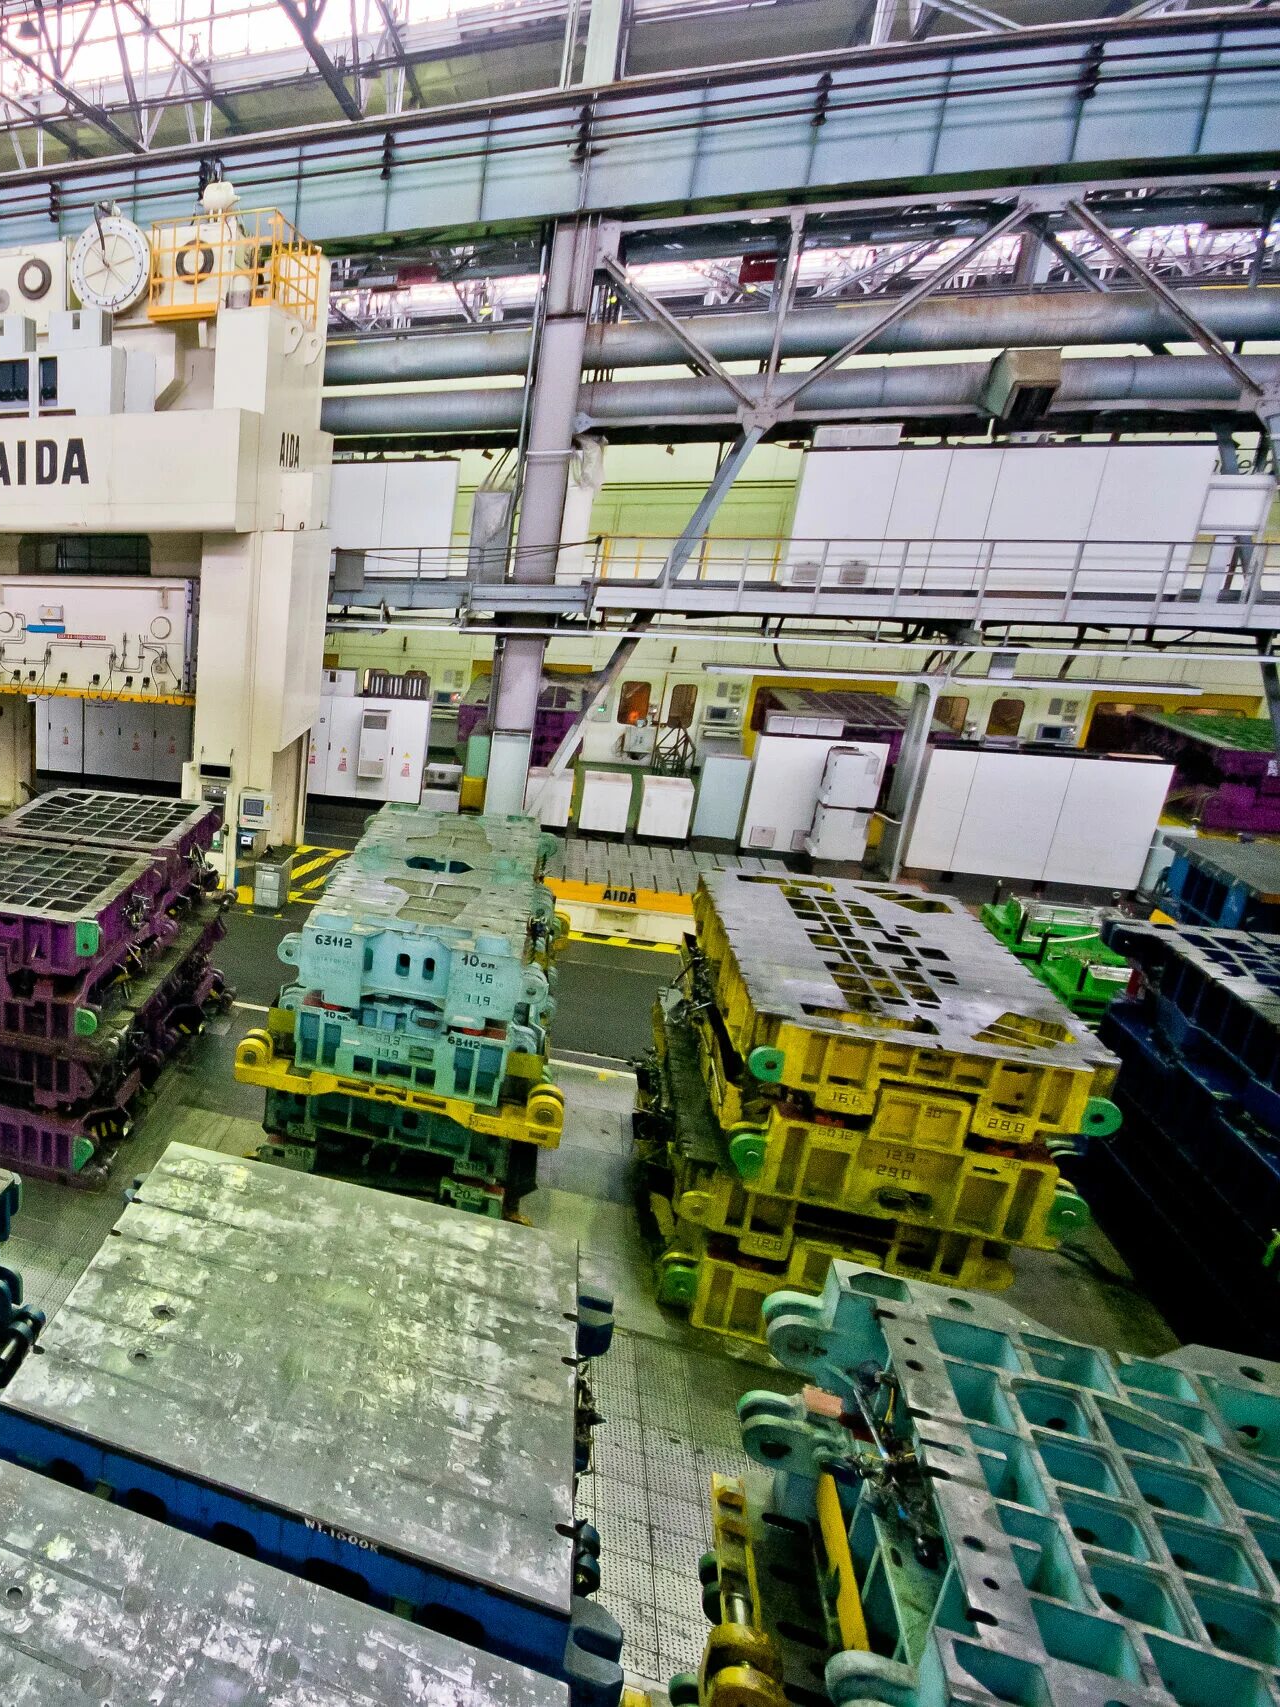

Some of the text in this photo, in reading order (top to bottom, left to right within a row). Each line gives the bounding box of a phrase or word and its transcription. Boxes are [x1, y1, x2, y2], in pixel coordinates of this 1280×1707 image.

[279, 431, 300, 468] AIDA
[603, 889, 637, 904] AIDA
[315, 934, 353, 948] 63112
[461, 954, 479, 967] 10
